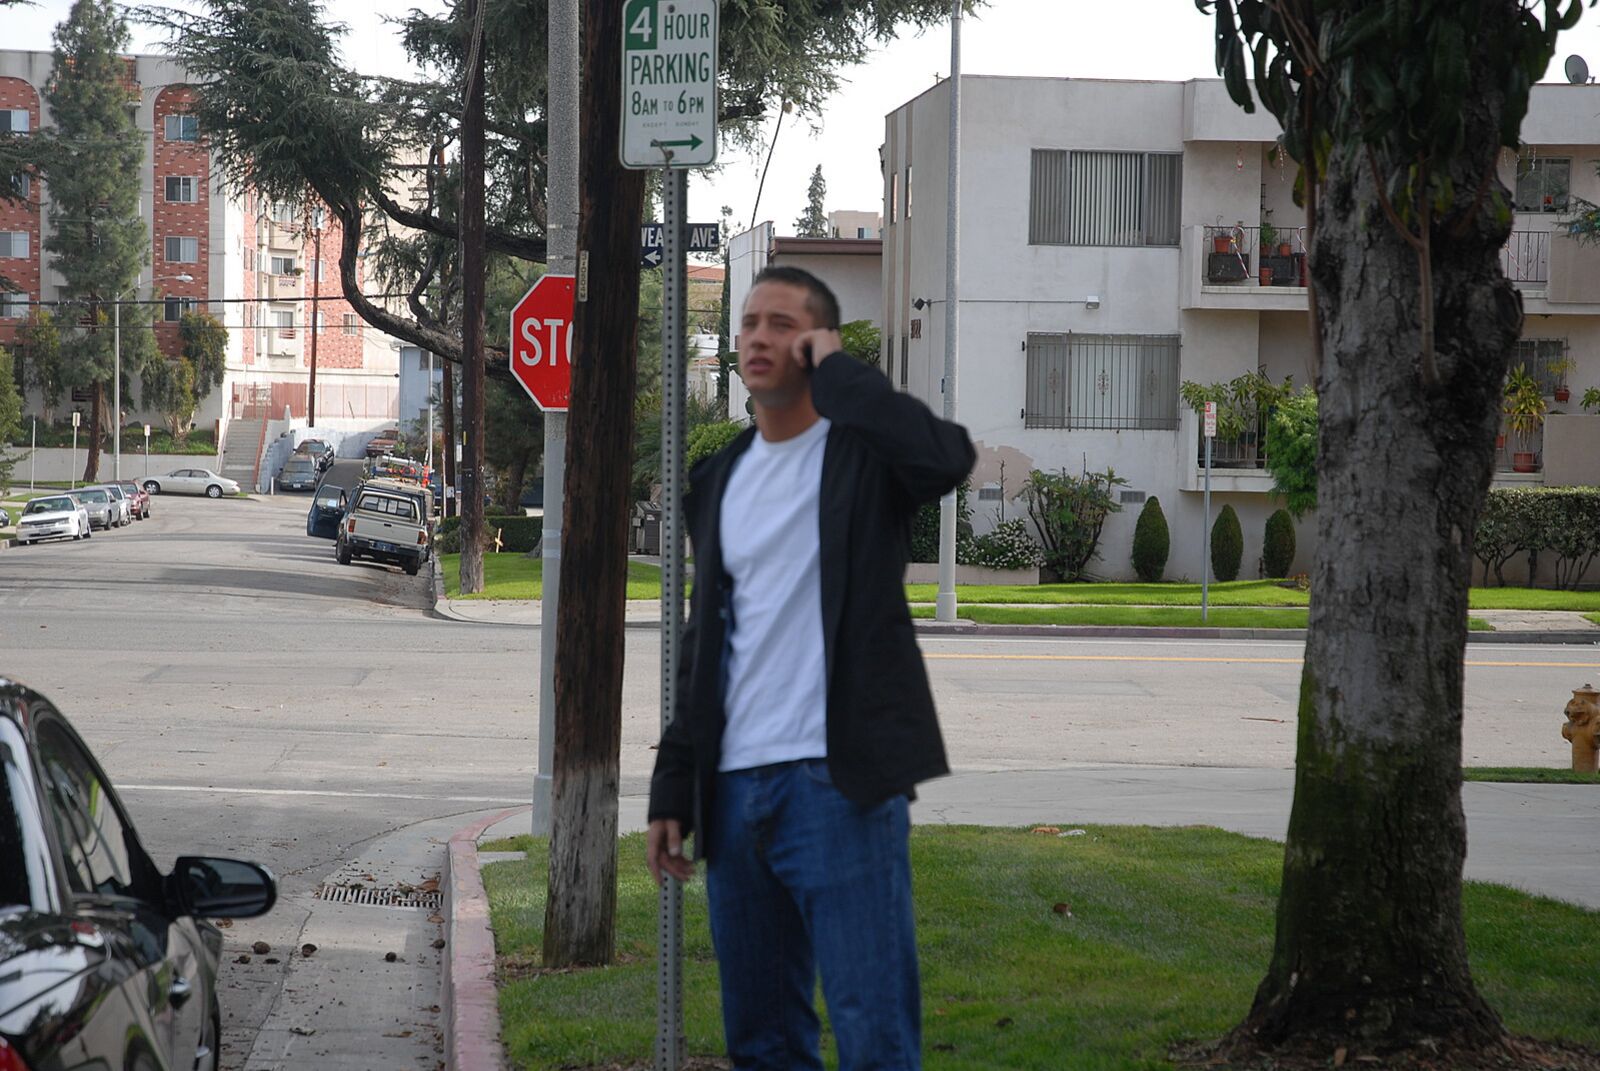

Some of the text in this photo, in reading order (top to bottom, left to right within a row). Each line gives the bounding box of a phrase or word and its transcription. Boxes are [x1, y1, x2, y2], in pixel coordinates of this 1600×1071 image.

[629, 6, 710, 43] 4 HOUR
[631, 51, 710, 86] PARKING
[631, 90, 659, 116] 8AM
[677, 90, 705, 115] 6PM
[519, 317, 574, 367] ST
